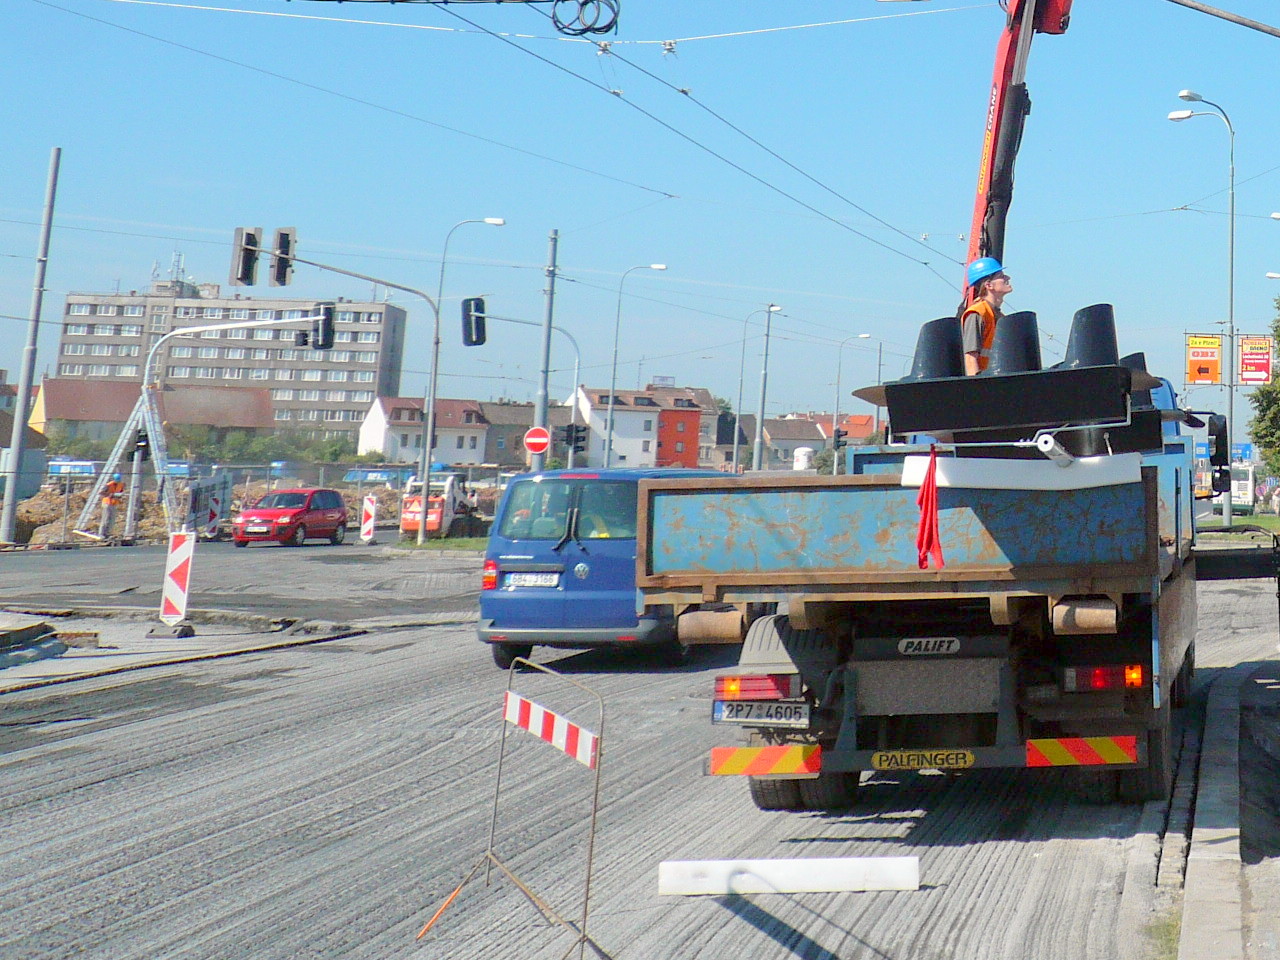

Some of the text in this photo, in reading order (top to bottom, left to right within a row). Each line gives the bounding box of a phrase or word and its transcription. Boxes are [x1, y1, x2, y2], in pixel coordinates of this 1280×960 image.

[903, 640, 955, 653] PALIFT
[726, 703, 803, 721] 2P7 4605
[879, 751, 968, 768] PALFINGER
